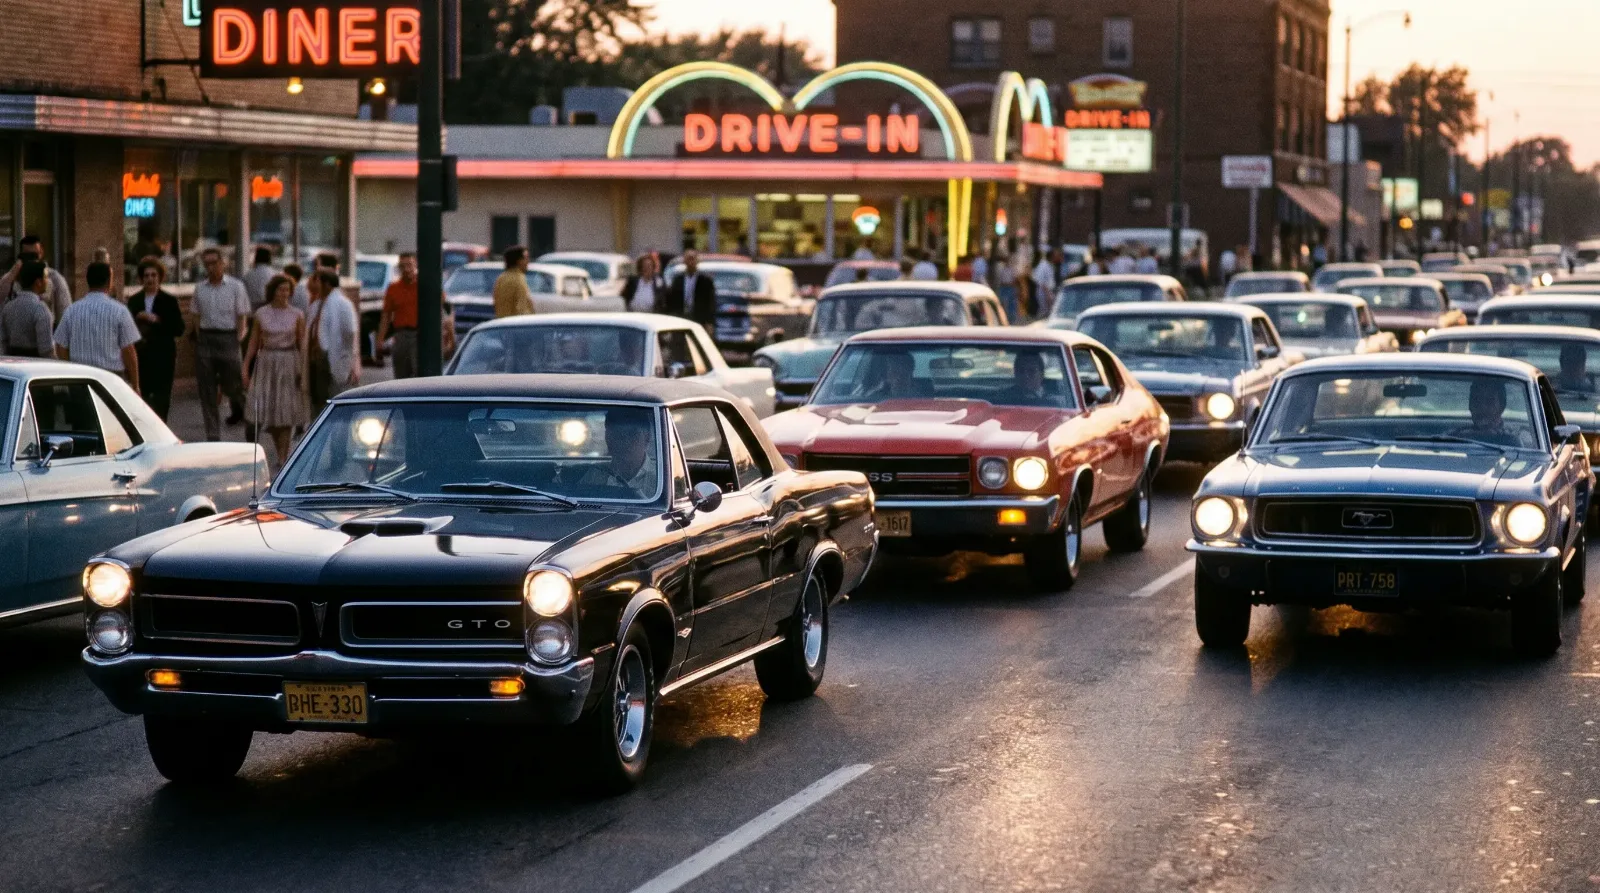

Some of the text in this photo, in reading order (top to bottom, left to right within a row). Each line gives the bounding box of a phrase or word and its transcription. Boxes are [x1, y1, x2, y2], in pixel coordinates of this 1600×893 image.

[212, 7, 420, 65] DINER
[1064, 109, 1151, 129] DRIVE-IN
[684, 113, 919, 153] DRIVE-IN
[869, 472, 893, 482] SS
[447, 619, 511, 629] GTO
